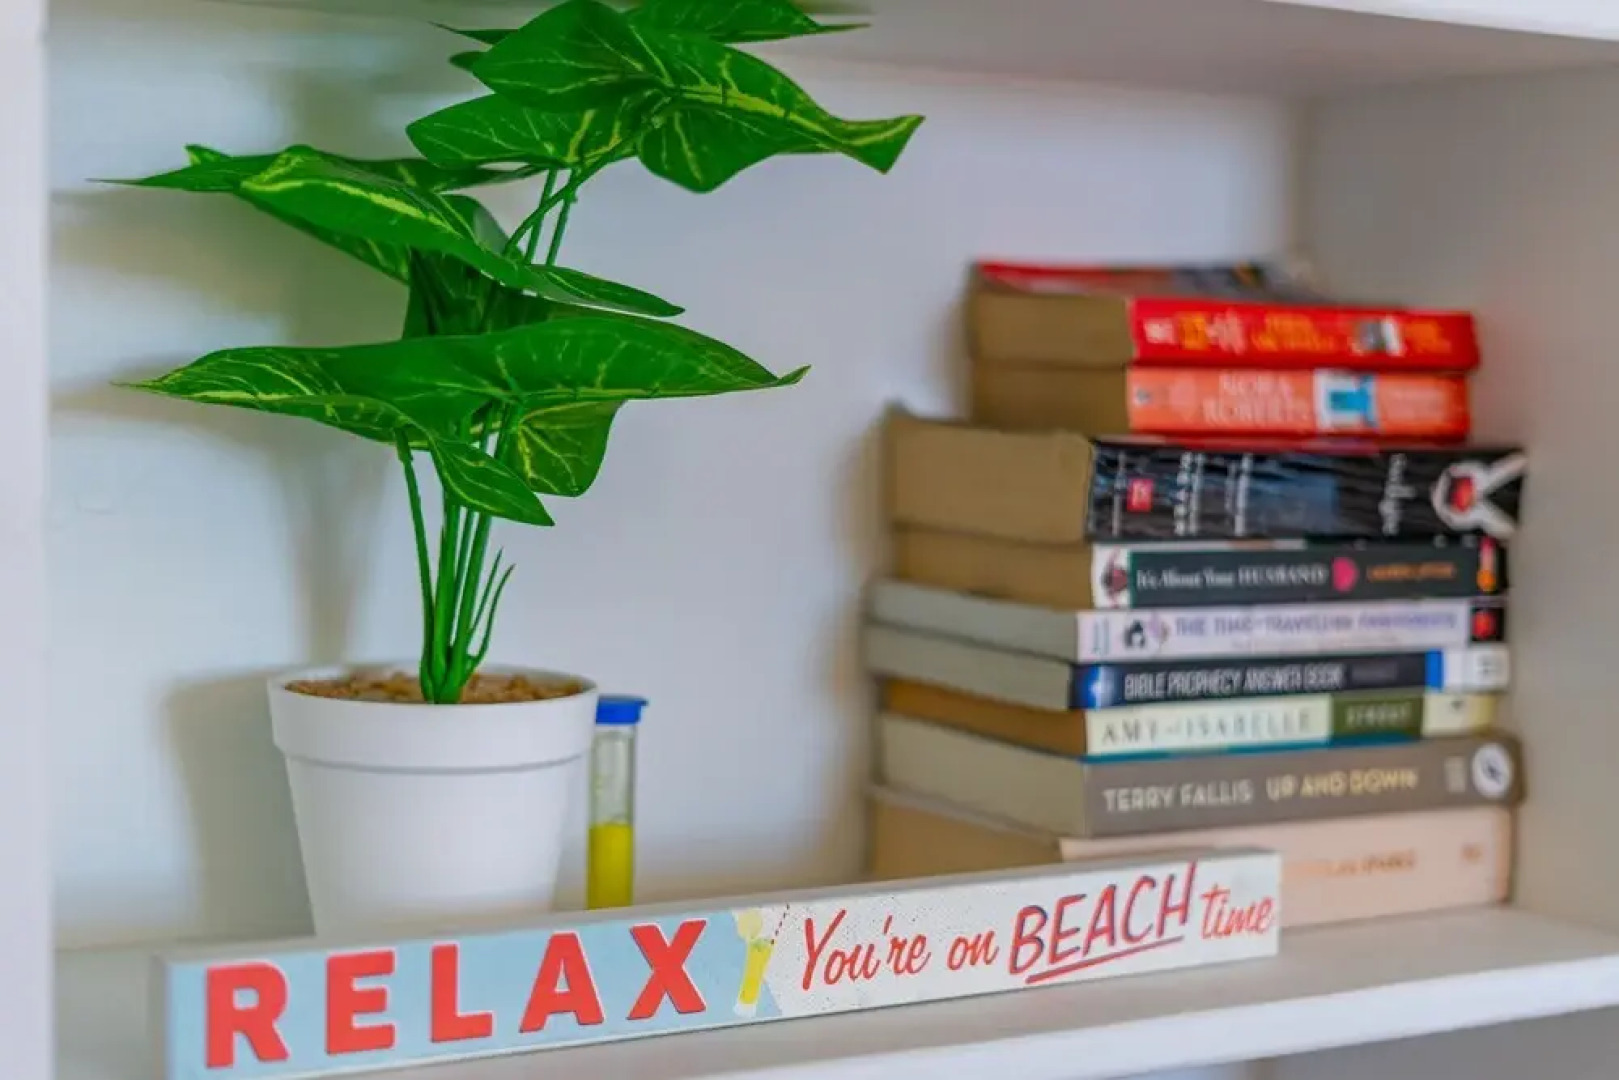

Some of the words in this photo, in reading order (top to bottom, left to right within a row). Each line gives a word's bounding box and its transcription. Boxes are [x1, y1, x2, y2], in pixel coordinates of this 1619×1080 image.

[1125, 673, 1165, 699] BIBLE
[1167, 669, 1241, 697] PROPHECY
[1243, 666, 1301, 692] ANSWER
[1102, 719, 1157, 744] AMY
[1186, 709, 1312, 739] ISABELLE
[1104, 786, 1174, 812] TERRY
[1180, 780, 1253, 808] FALLIS
[1266, 774, 1296, 801] UP
[1302, 770, 1344, 798] AND
[1349, 768, 1418, 794] DOWN
[205, 919, 708, 1069] RELAX
[802, 908, 931, 991] You're
[946, 928, 1001, 970] on
[1008, 860, 1198, 977] BEACH
[1199, 882, 1275, 940] time
